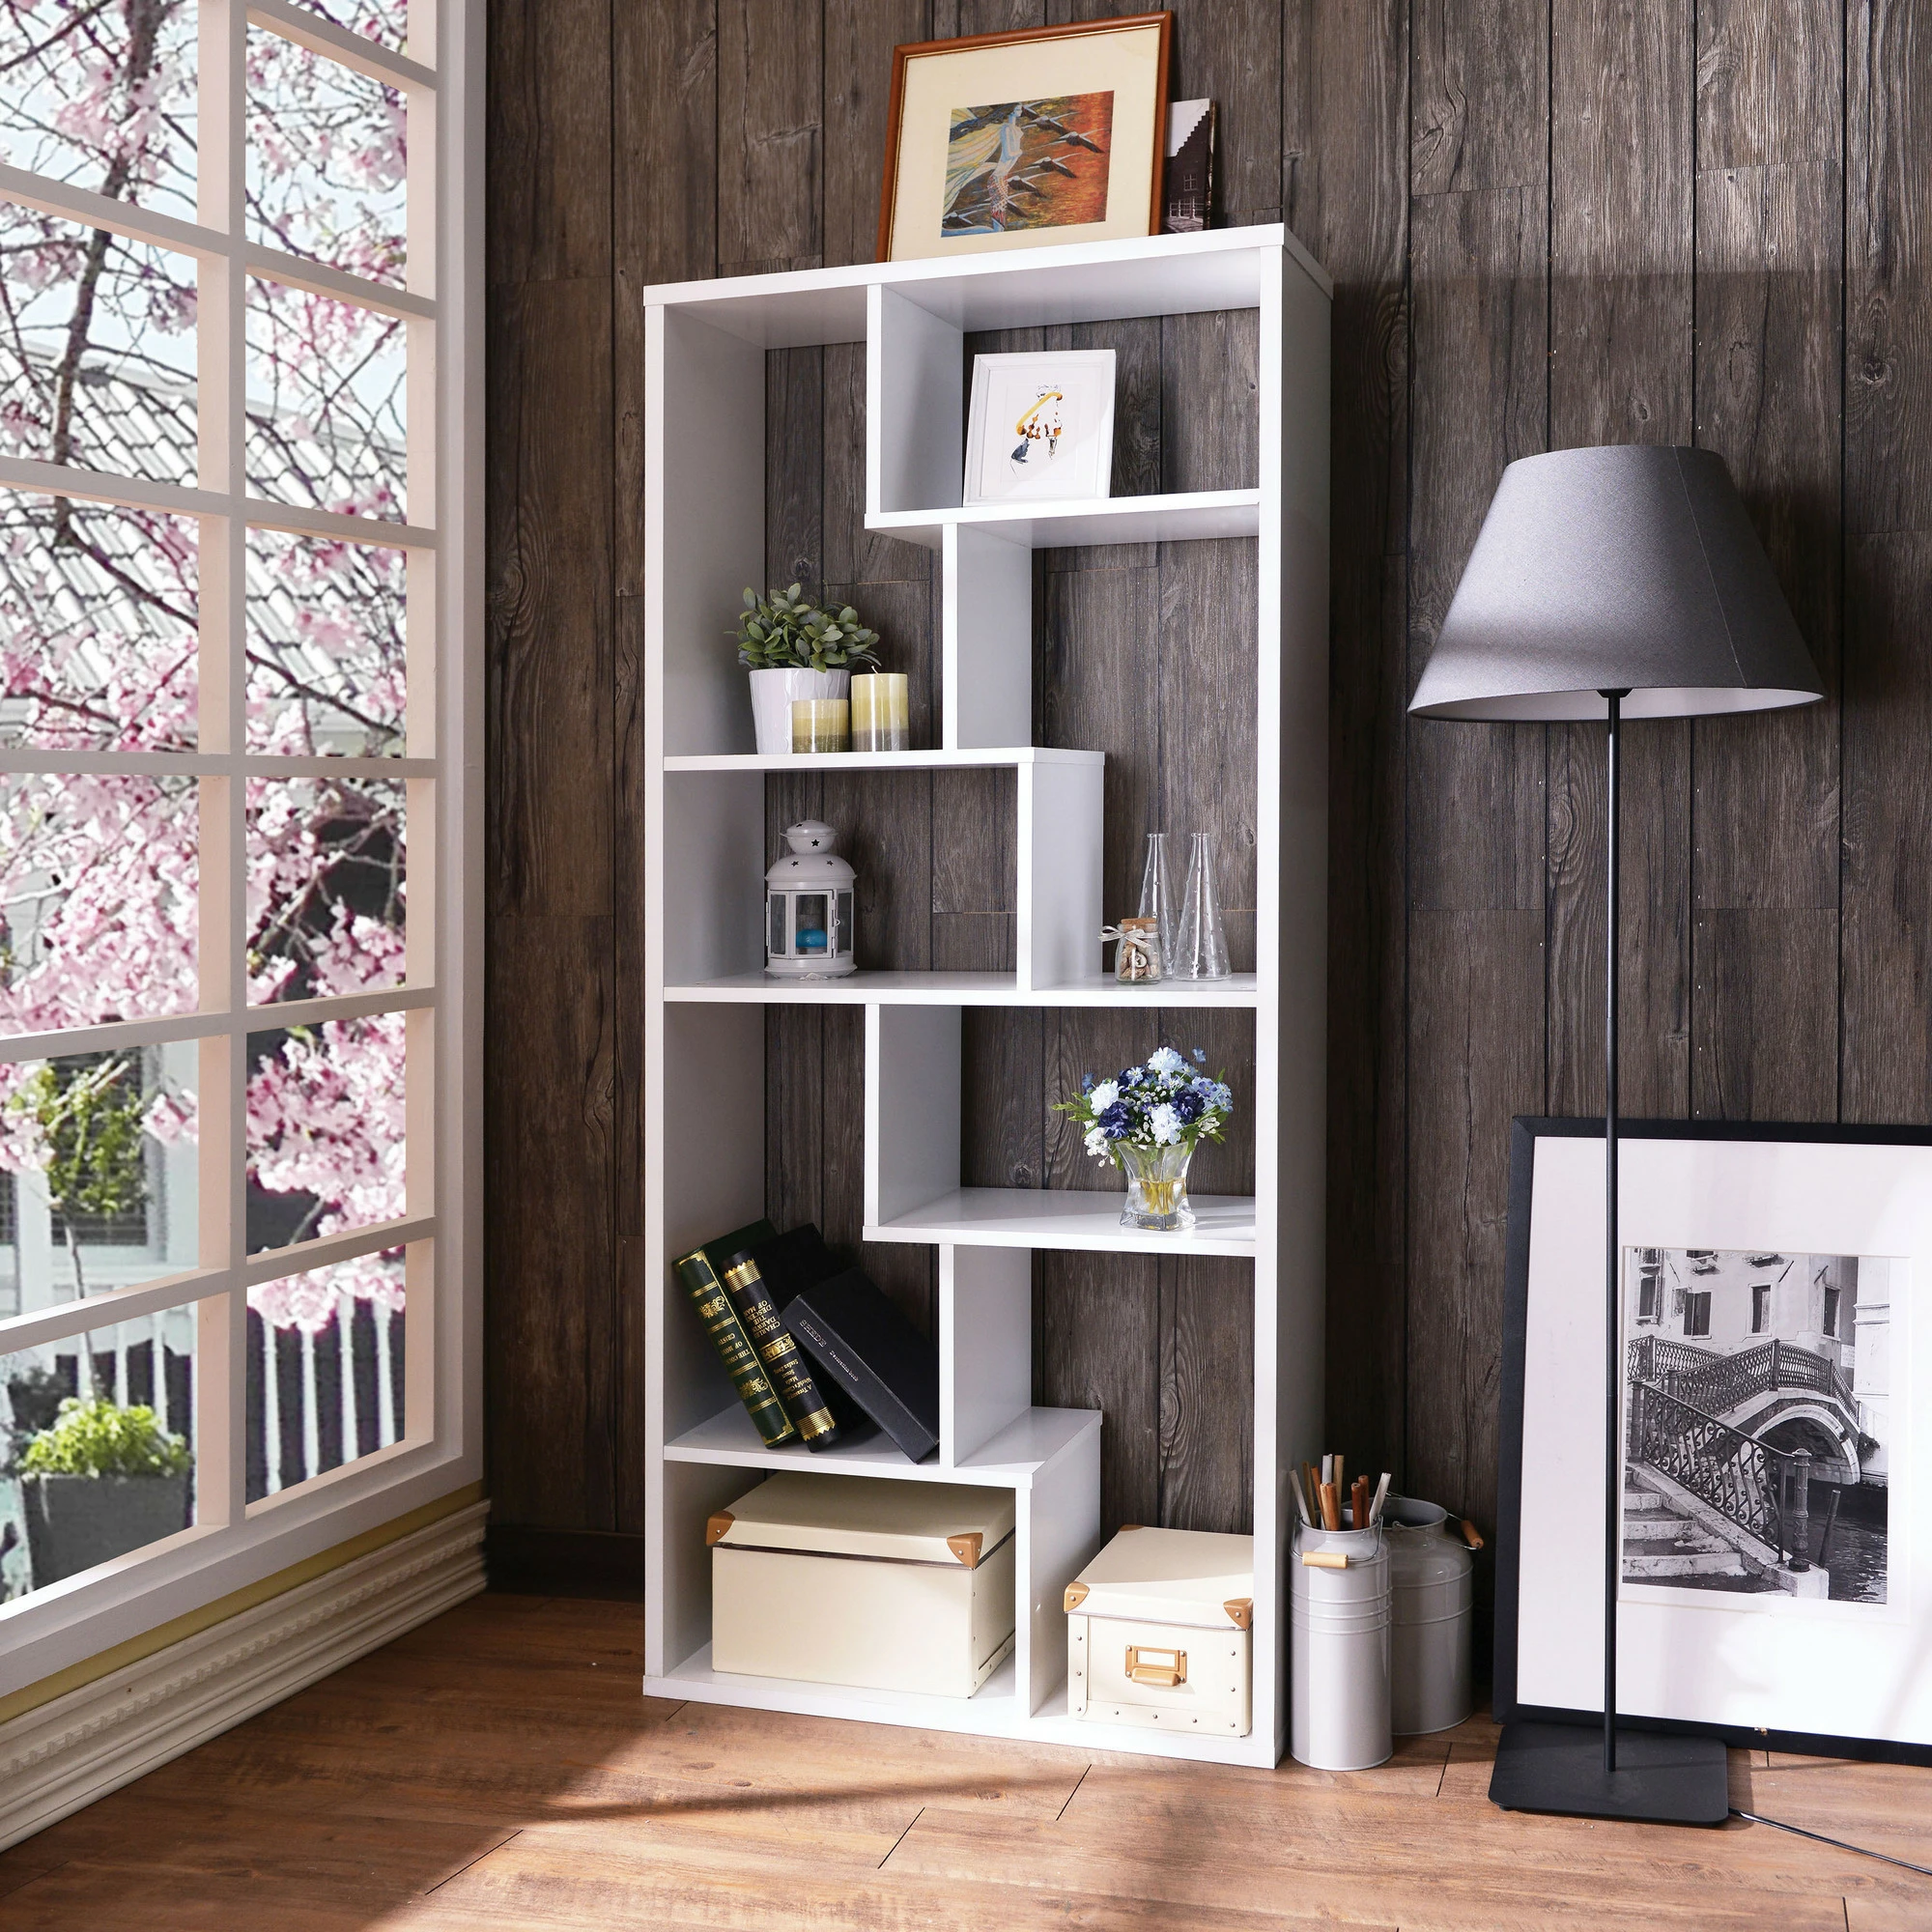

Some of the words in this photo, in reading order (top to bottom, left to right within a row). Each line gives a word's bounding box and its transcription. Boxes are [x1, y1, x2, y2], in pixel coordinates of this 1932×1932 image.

[756, 1299, 767, 1308] OF
[753, 1315, 766, 1324] THE
[733, 1340, 743, 1349] OF
[736, 1348, 750, 1358] THE
